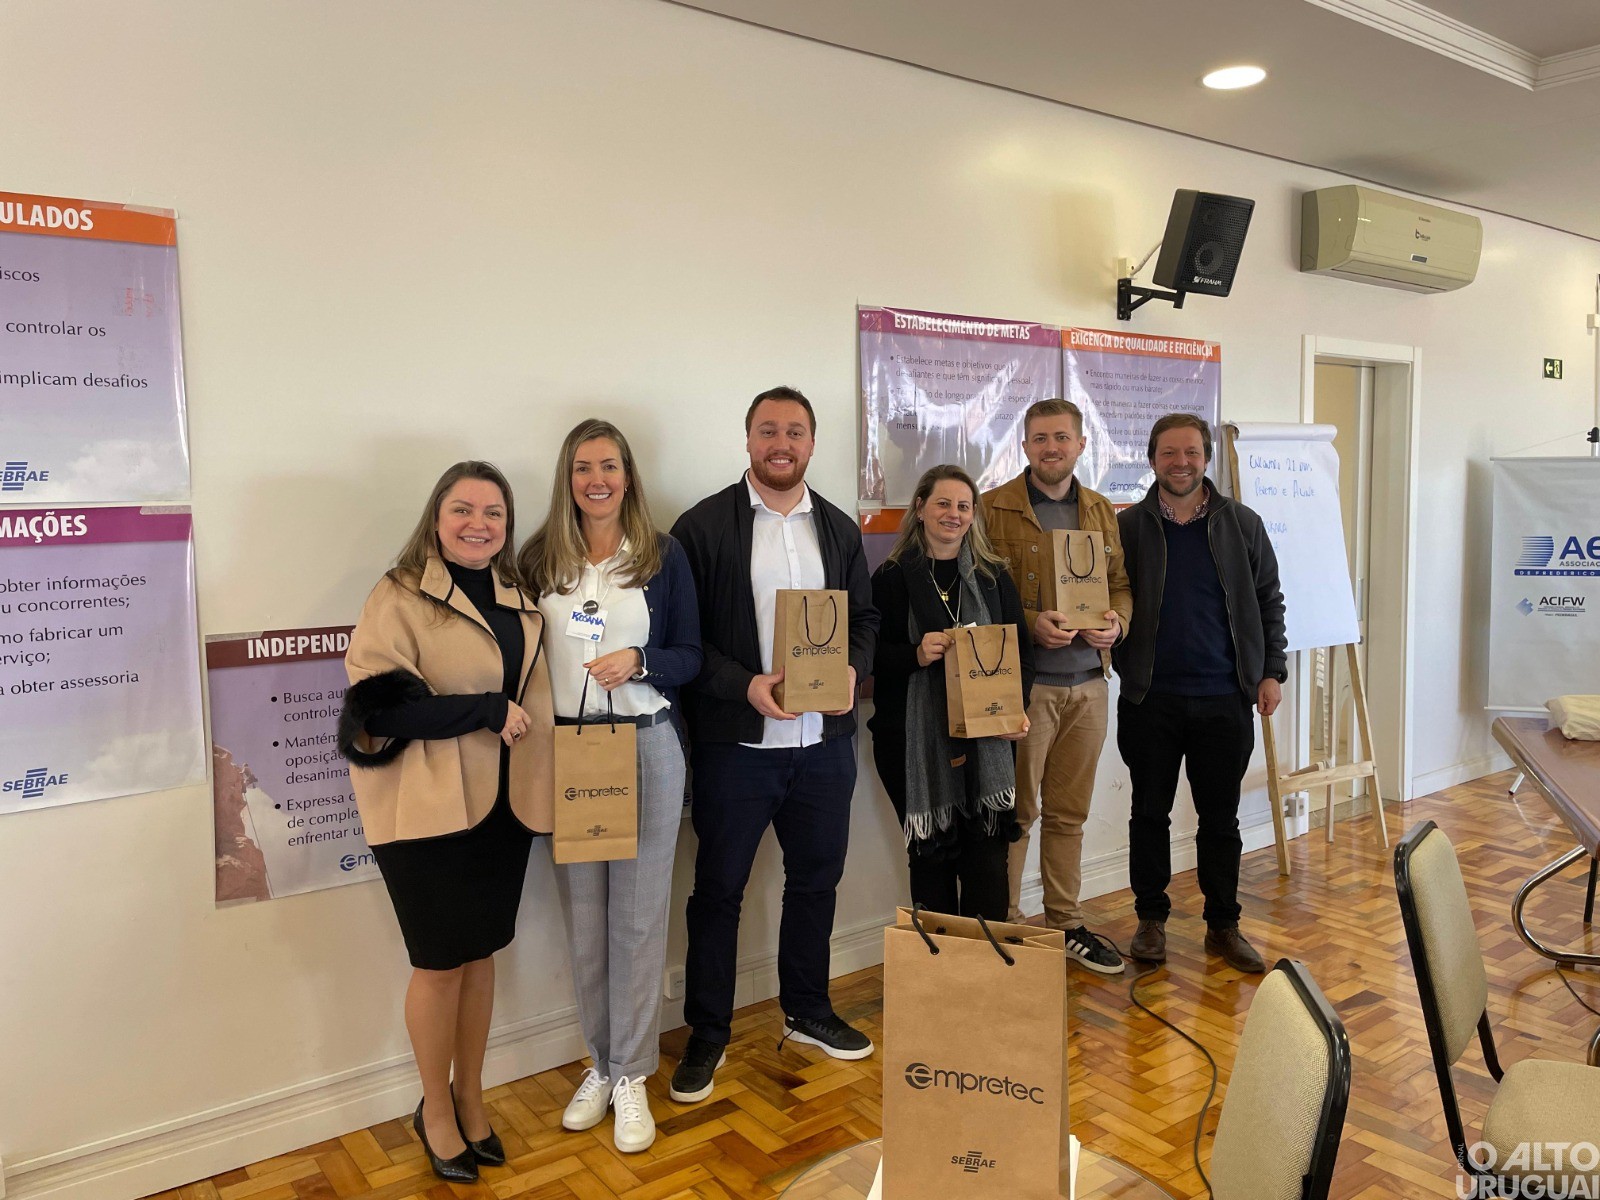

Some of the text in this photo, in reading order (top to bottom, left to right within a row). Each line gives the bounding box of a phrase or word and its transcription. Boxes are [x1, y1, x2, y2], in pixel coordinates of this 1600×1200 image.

[0, 202, 94, 231] ULADOS
[5, 320, 107, 337] controlar os
[894, 313, 1030, 340] ESTABELECIMENTO DE METAS
[1071, 331, 1213, 357] EXIGÊNCIA DE QUALIDADE E EFICIÊNCIA
[934, 359, 955, 368] metas
[83, 372, 149, 388] desafios
[943, 374, 955, 382] que
[934, 390, 943, 399] de
[945, 390, 964, 402] longo
[0, 511, 88, 543] MAÇÕES
[47, 574, 147, 591] informações
[18, 596, 130, 613] concorrentes;
[1539, 596, 1585, 606] ACIFW
[29, 627, 92, 642] fabricar
[98, 626, 123, 638] um
[11, 680, 55, 695] obter
[60, 670, 139, 690] assessoria
[283, 692, 322, 704] Busca
[285, 732, 340, 749] Mantém
[2, 774, 69, 792] SEBRAE
[286, 767, 350, 784] desanima
[287, 794, 344, 811] Expressa
[287, 816, 304, 829] de
[288, 828, 348, 847] enfrentar
[951, 1154, 997, 1169] SEBRAE
